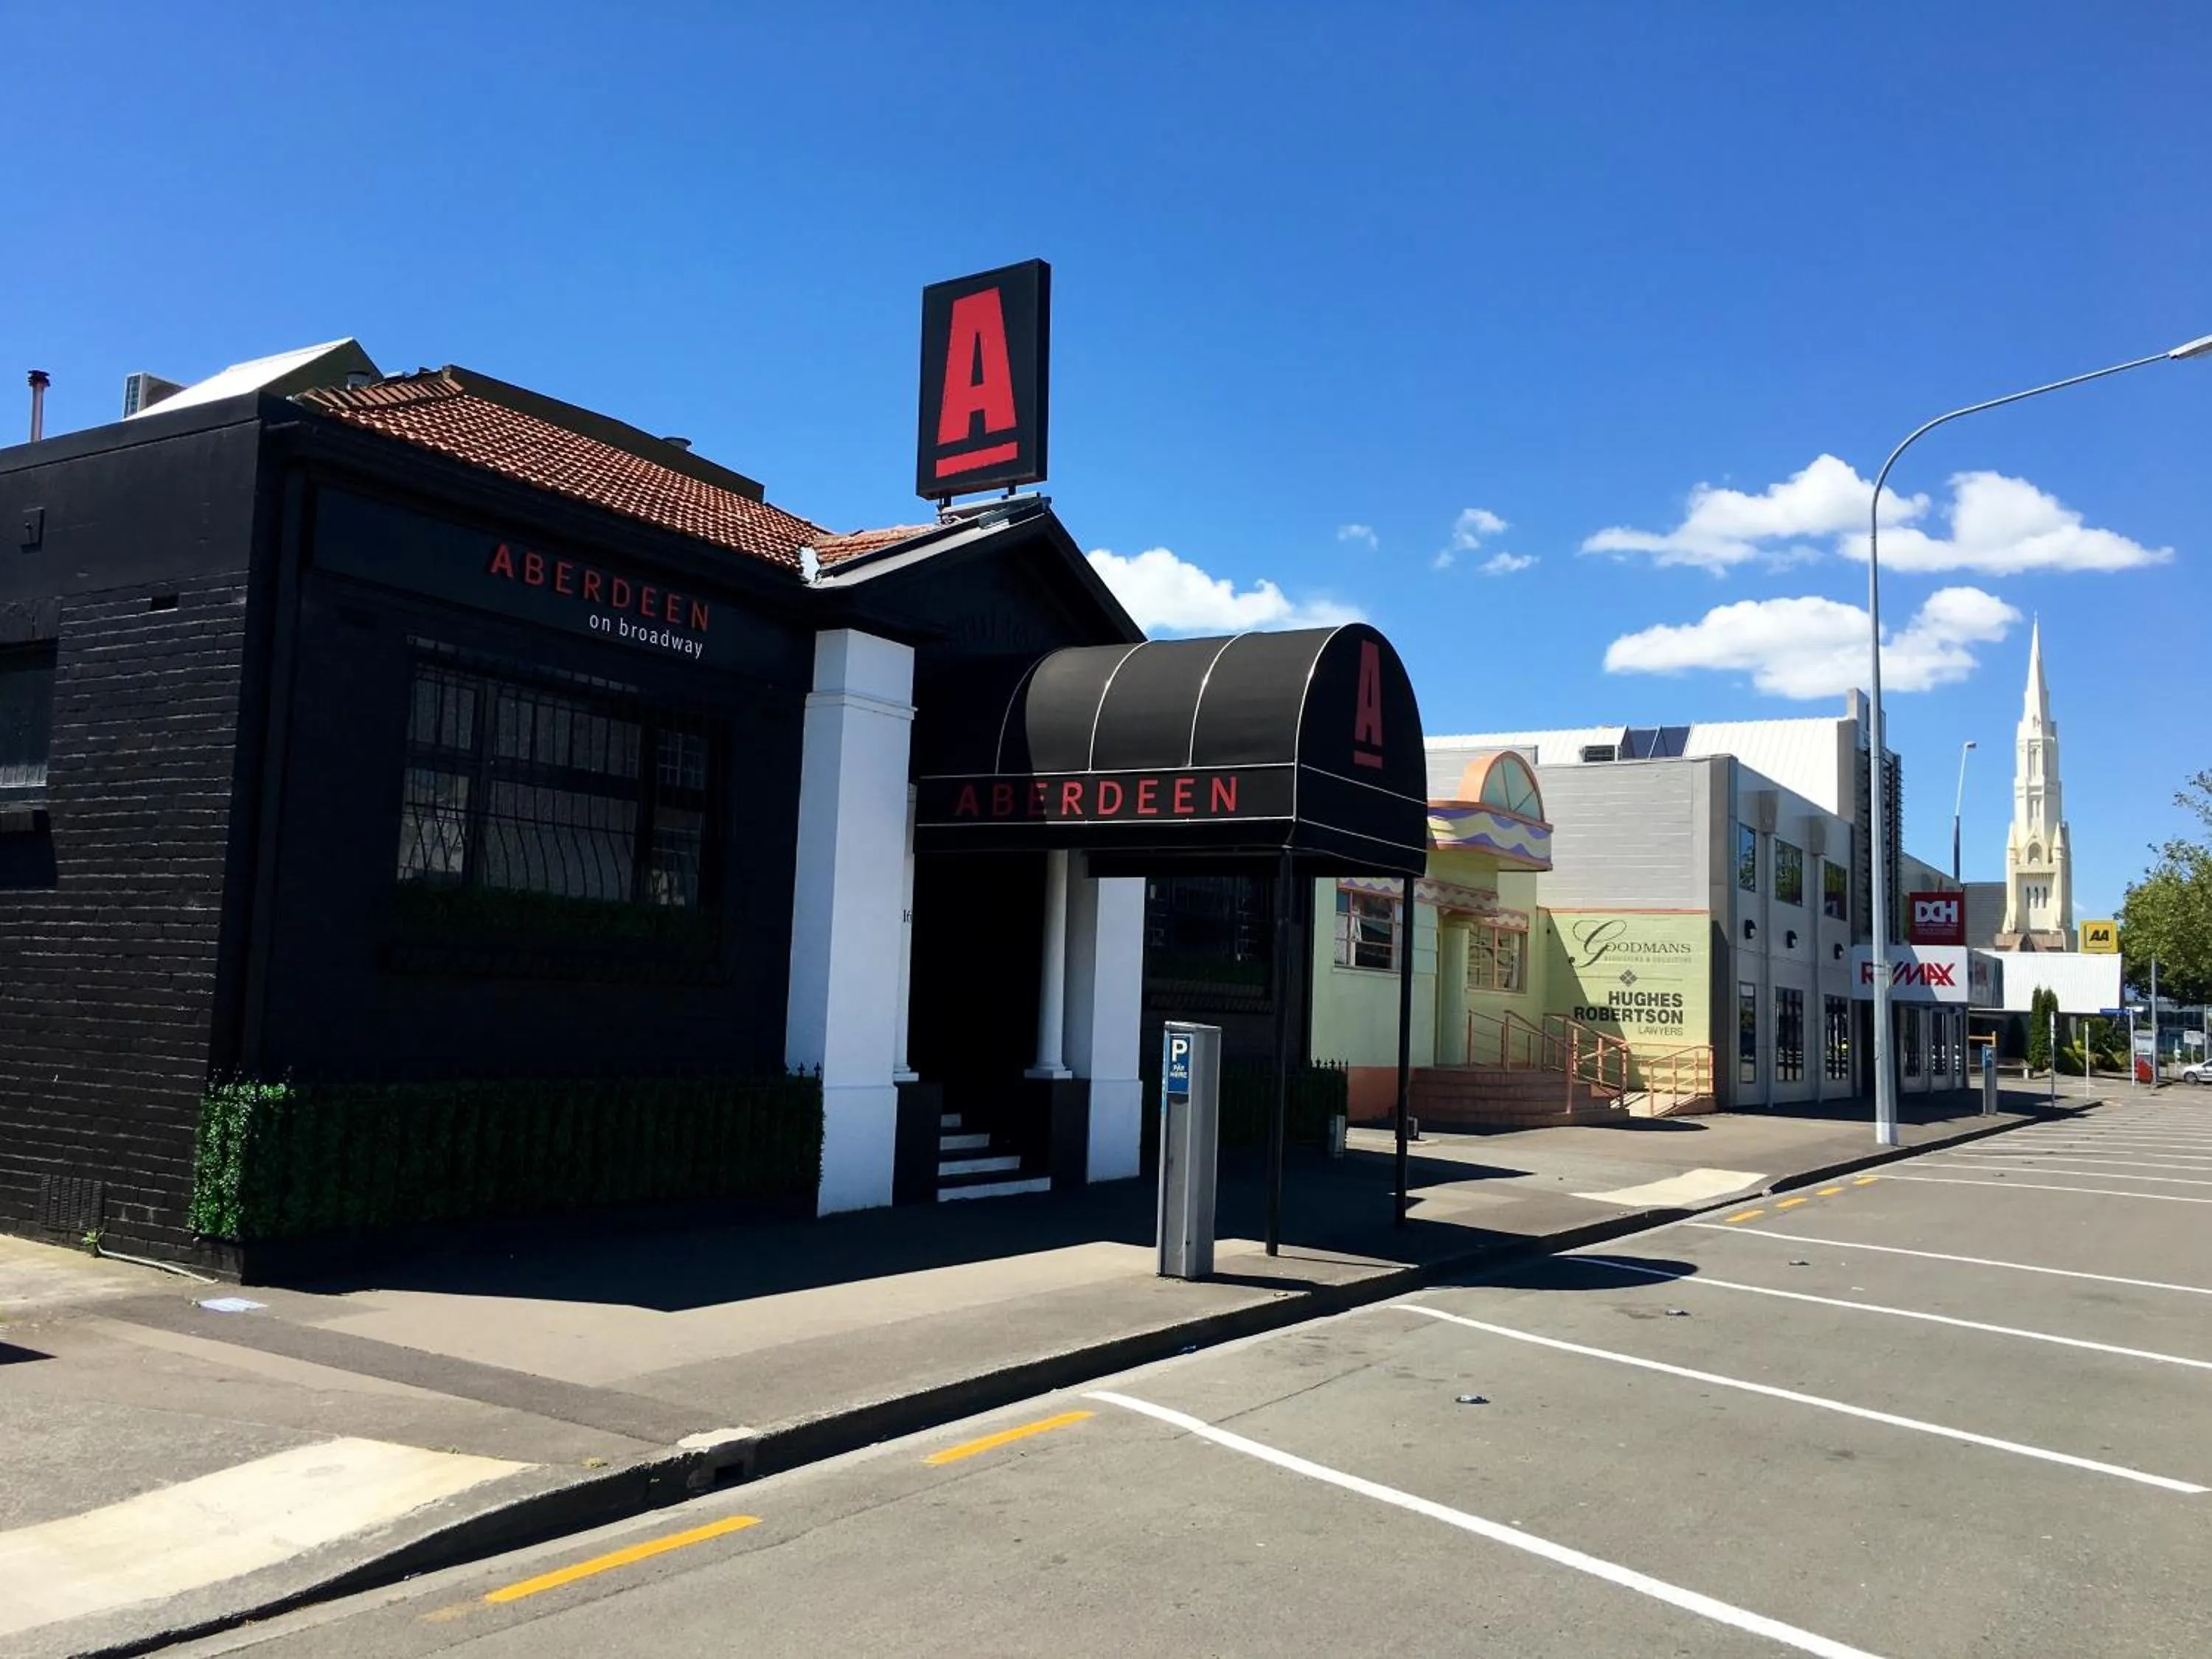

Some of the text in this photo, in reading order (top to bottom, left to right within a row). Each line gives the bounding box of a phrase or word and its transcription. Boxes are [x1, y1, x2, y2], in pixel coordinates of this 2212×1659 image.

[937, 287, 1017, 445] A
[490, 543, 709, 632] ABERDEEN
[589, 613, 703, 660] on broadway
[1354, 640, 1383, 757] A
[956, 776, 1239, 818] ABERDEEN
[1915, 900, 1958, 922] DCH
[1572, 919, 1691, 969] GOODMANS
[2089, 929, 2110, 942] AA
[1860, 961, 1956, 986] R/MAX
[1608, 991, 1683, 1008] HUGHES
[1573, 1006, 1684, 1024] ROBERTSON
[1638, 1026, 1684, 1037] LAWYERS
[1172, 1039, 1188, 1062] P
